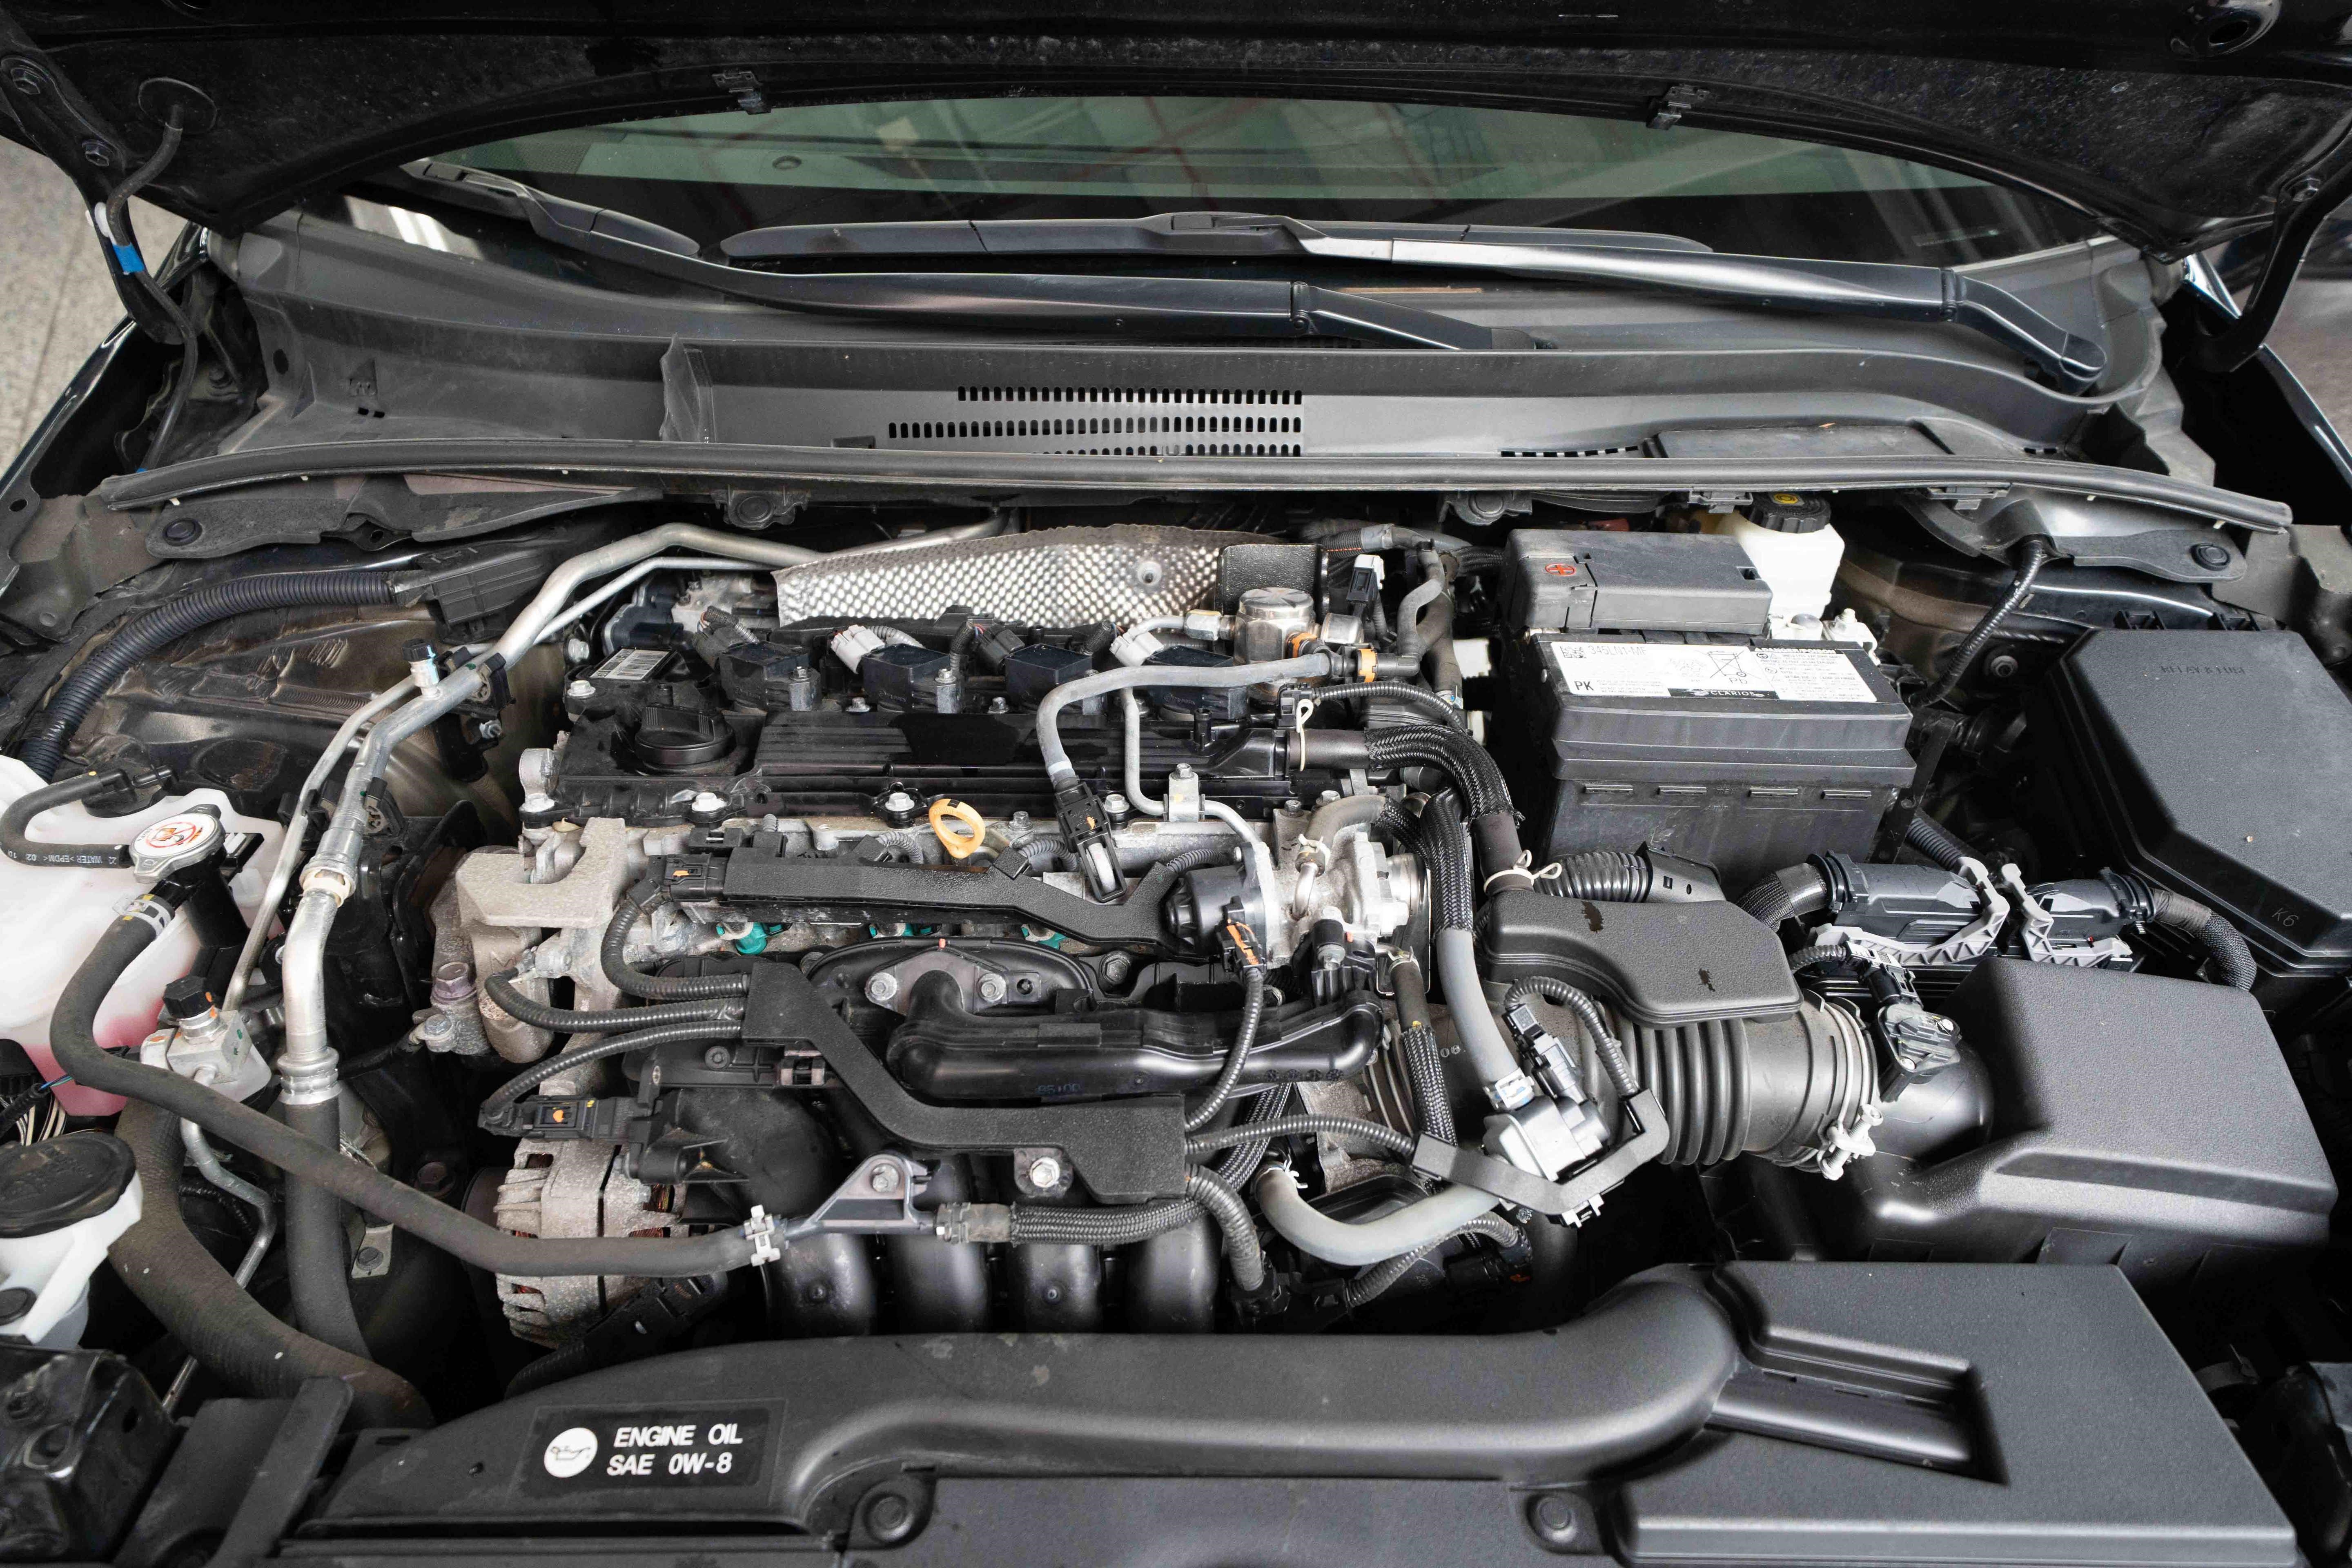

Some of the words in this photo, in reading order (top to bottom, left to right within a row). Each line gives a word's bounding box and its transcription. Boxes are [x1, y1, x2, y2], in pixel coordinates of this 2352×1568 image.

[1574, 681, 1594, 691] PK
[76, 855, 102, 864] WATER
[2272, 907, 2299, 927] K6
[613, 1425, 697, 1448] ENGINE
[708, 1423, 743, 1445] OIL
[606, 1454, 656, 1476] SAE
[668, 1452, 733, 1475] 0W-8
